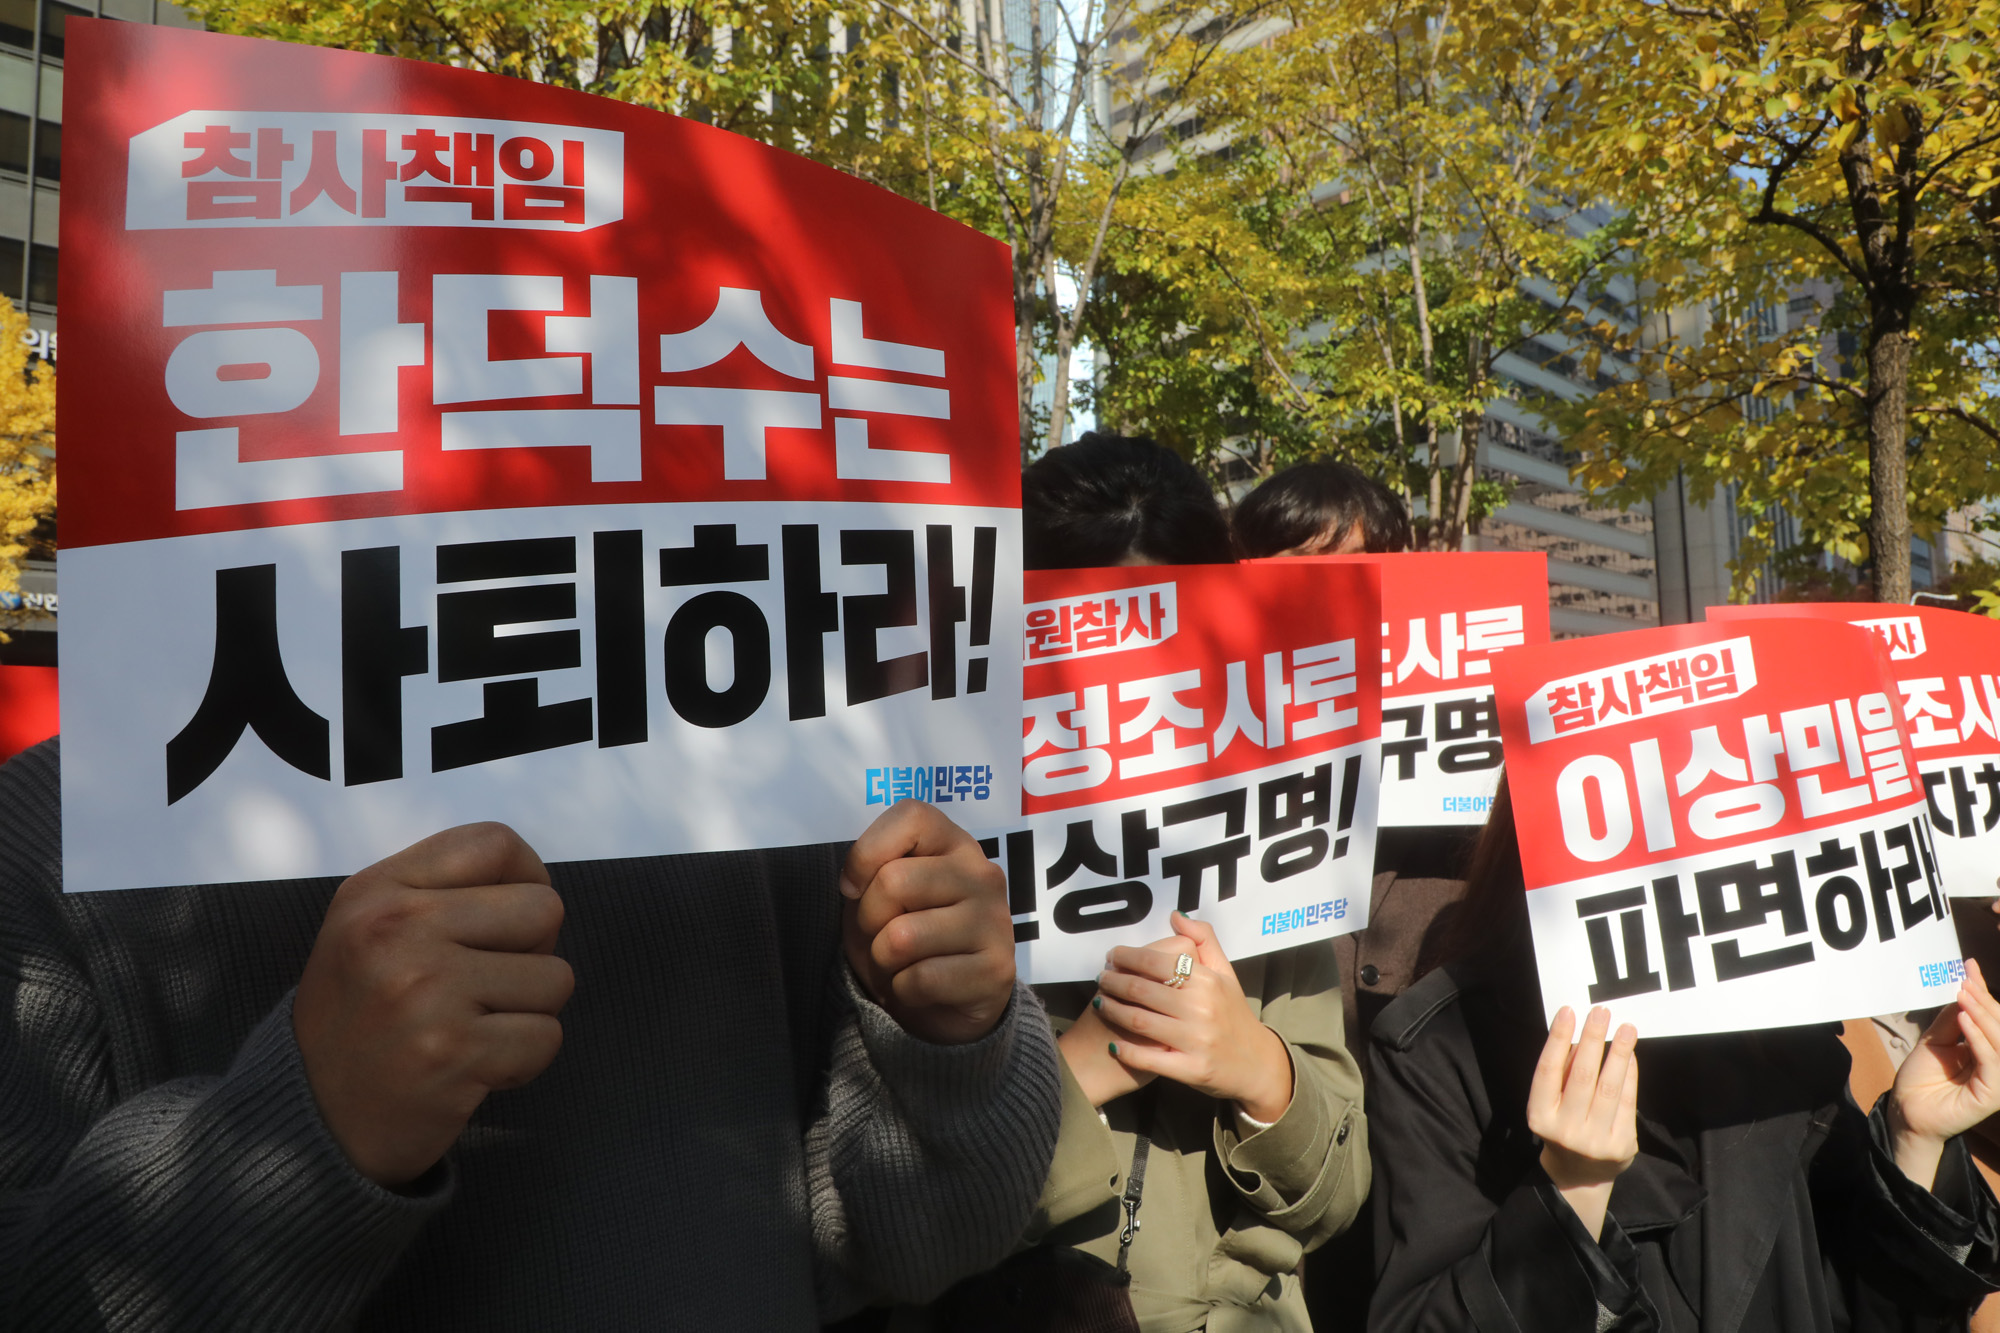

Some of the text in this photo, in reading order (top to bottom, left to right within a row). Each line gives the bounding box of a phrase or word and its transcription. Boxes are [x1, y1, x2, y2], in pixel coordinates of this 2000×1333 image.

[181, 125, 585, 225] 참사책임
[20, 328, 57, 361] 의
[163, 269, 951, 511] 한덕수는
[166, 523, 997, 806] 사퇴하라!
[1023, 592, 1166, 660] 원참사
[1381, 605, 1524, 687] 사로
[1547, 648, 1739, 735] 참사책임
[866, 765, 992, 806] 더불어민주당
[1443, 796, 1495, 812] 더불어
[1556, 692, 1913, 862] 이상민을
[1262, 898, 1348, 936] 더불어민주당
